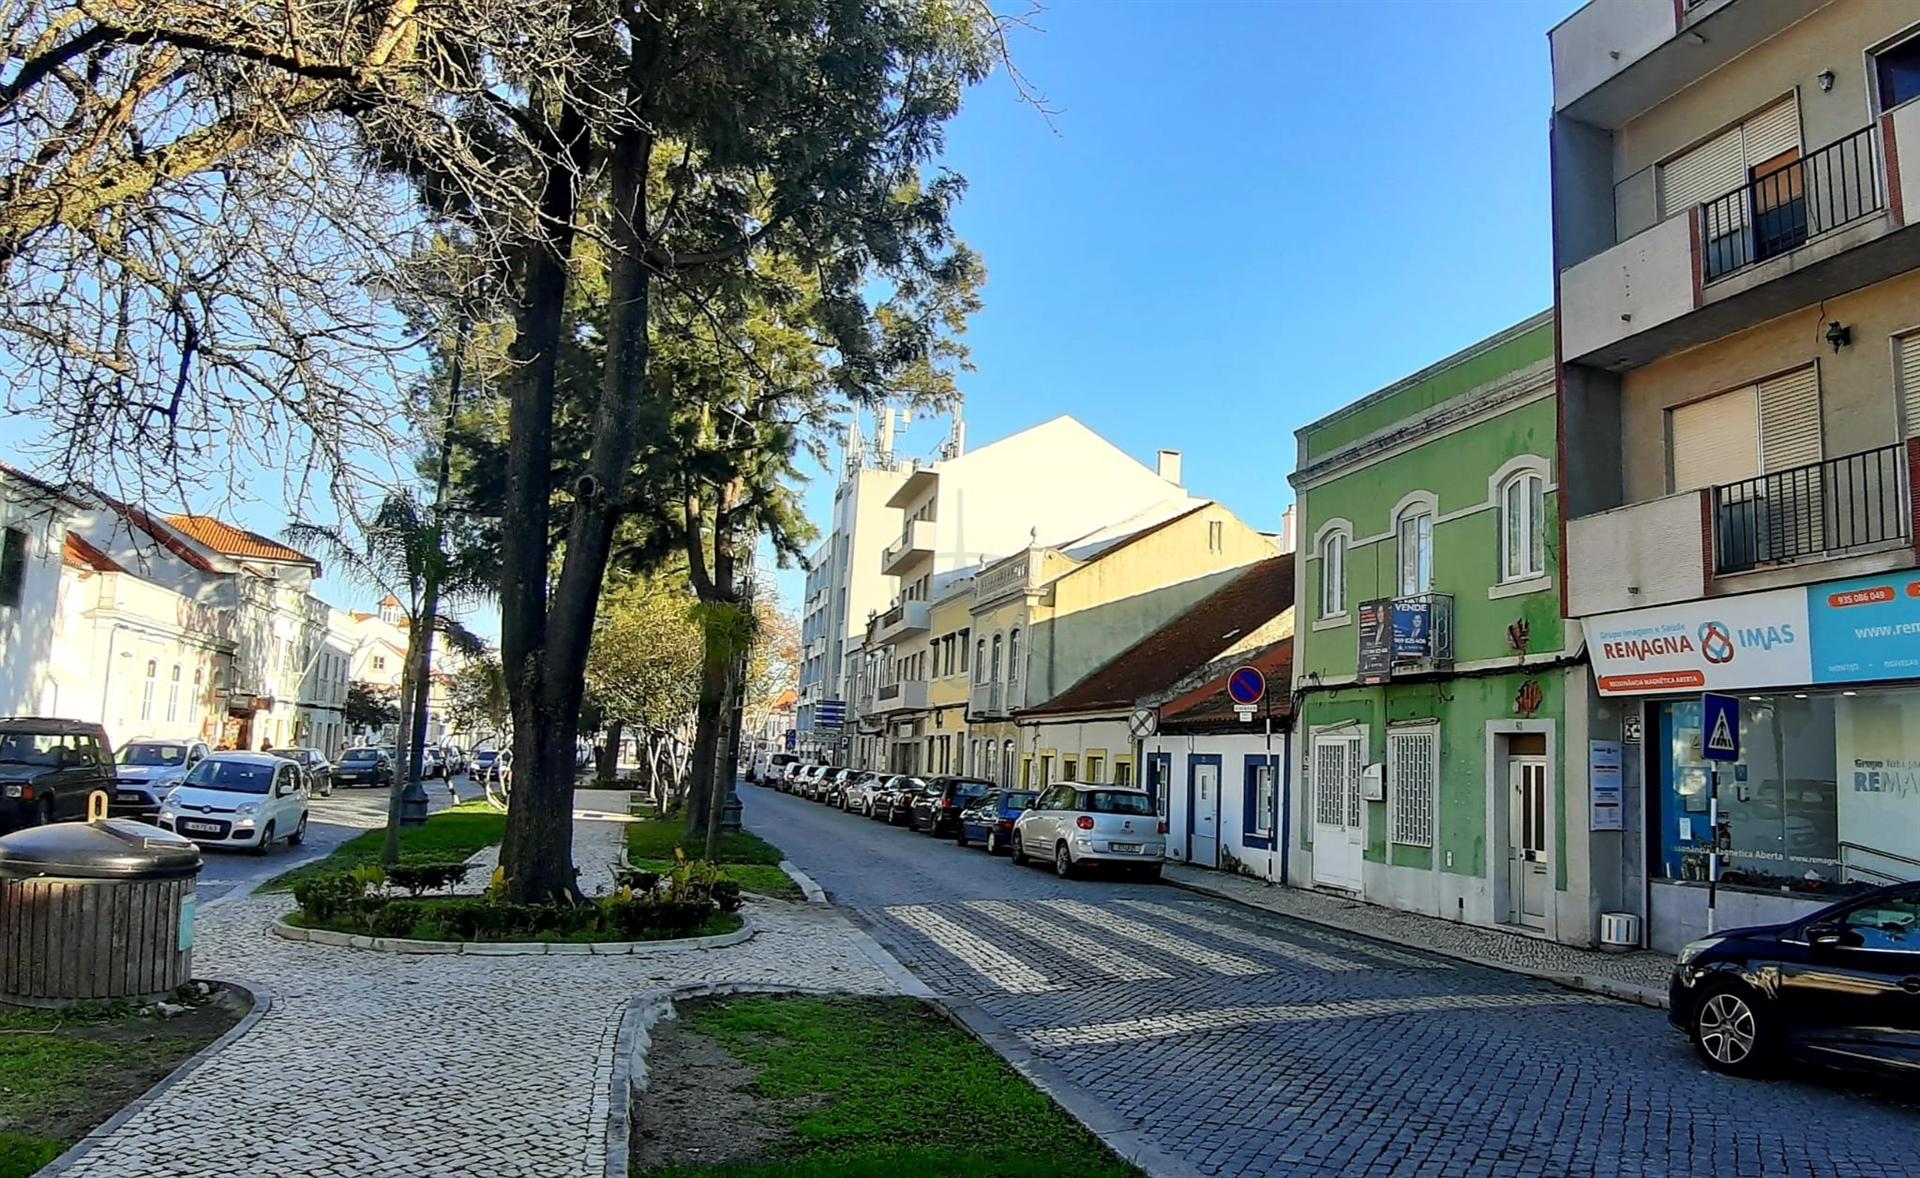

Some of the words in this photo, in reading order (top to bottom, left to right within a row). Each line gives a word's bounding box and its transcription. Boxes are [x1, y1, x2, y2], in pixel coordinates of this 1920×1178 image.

[1837, 596, 1853, 605] 935
[1853, 593, 1869, 602] 086
[1869, 590, 1885, 600] 049
[1395, 603, 1427, 612] VENDE
[1603, 635, 1695, 661] REMAGNA
[1737, 624, 1794, 651] IMAS
[841, 737, 849, 748] P
[1854, 758, 1883, 770] Grupo
[1755, 850, 1784, 861] Aberta
